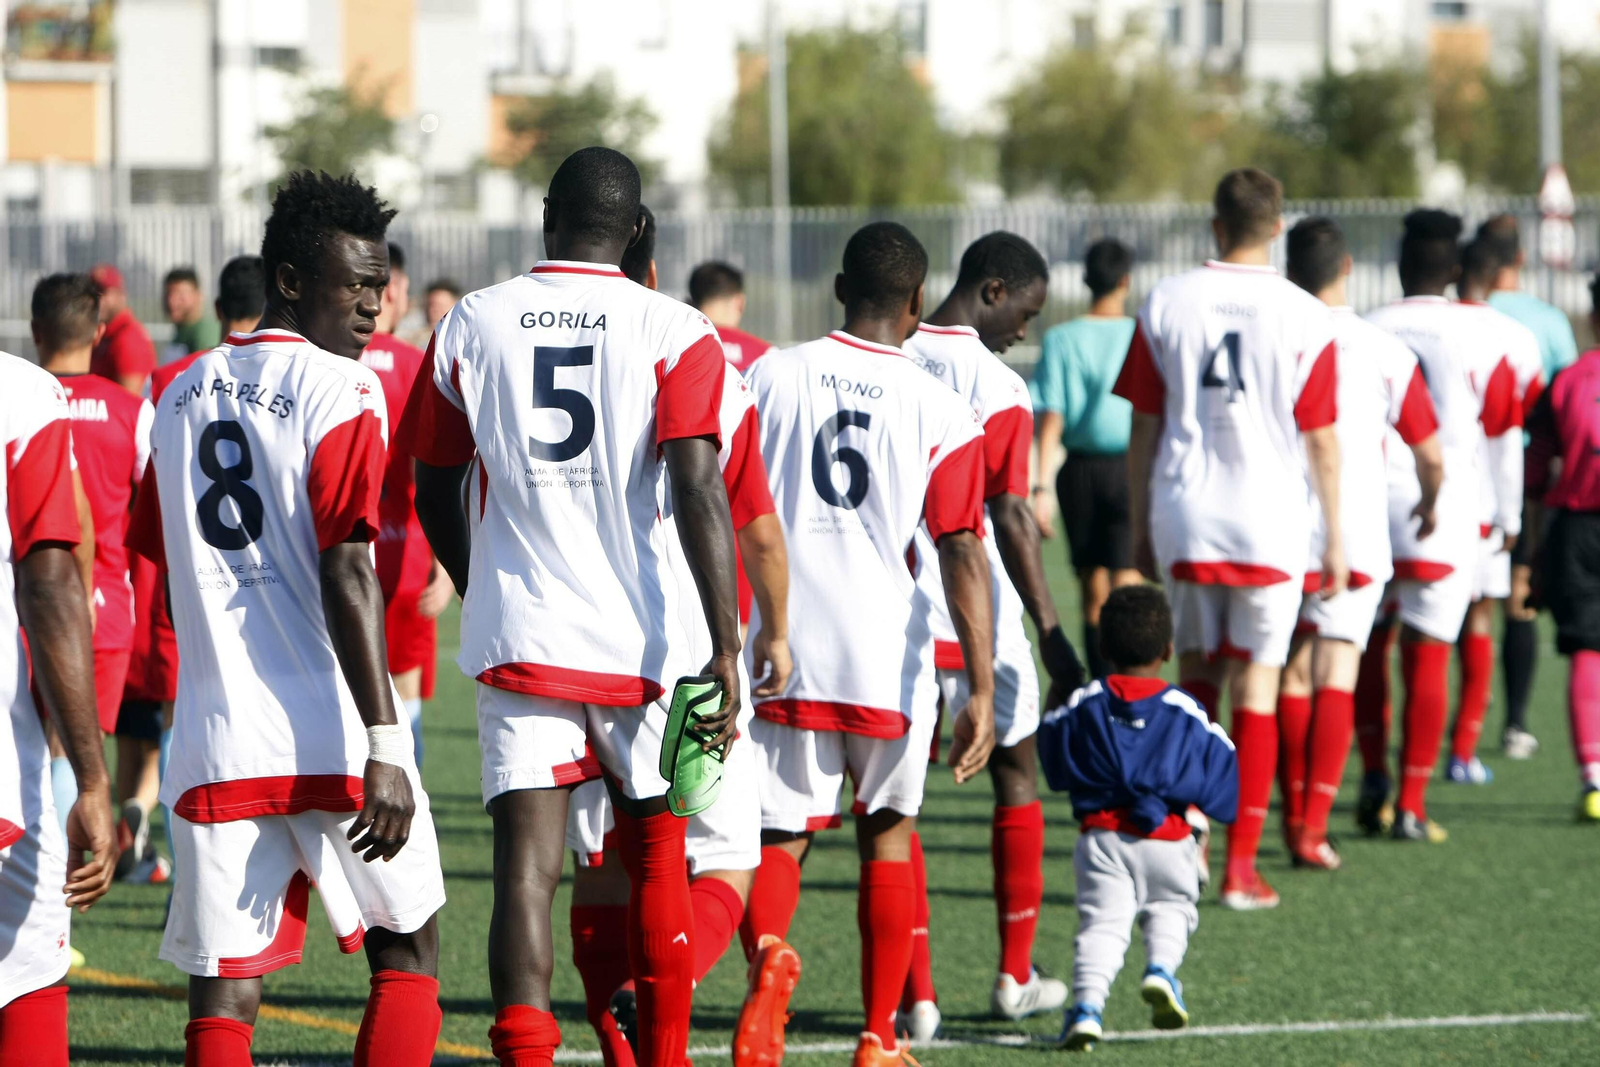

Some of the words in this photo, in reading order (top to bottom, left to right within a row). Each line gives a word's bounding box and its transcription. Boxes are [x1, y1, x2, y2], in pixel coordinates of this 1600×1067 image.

[520, 311, 607, 331] GORILA
[1201, 331, 1245, 403] 4
[175, 380, 203, 415] SIN
[821, 374, 883, 399] MONO
[529, 345, 596, 462] 5
[524, 468, 547, 476] ALMA
[552, 468, 565, 476] DE
[569, 466, 599, 476] ÁFRICA
[811, 409, 872, 511] 6
[195, 420, 264, 551] 8
[526, 479, 553, 489] UNIÓN
[558, 479, 604, 489] DEPORTIVA
[197, 566, 225, 576] ALMA
[230, 564, 245, 574] DE
